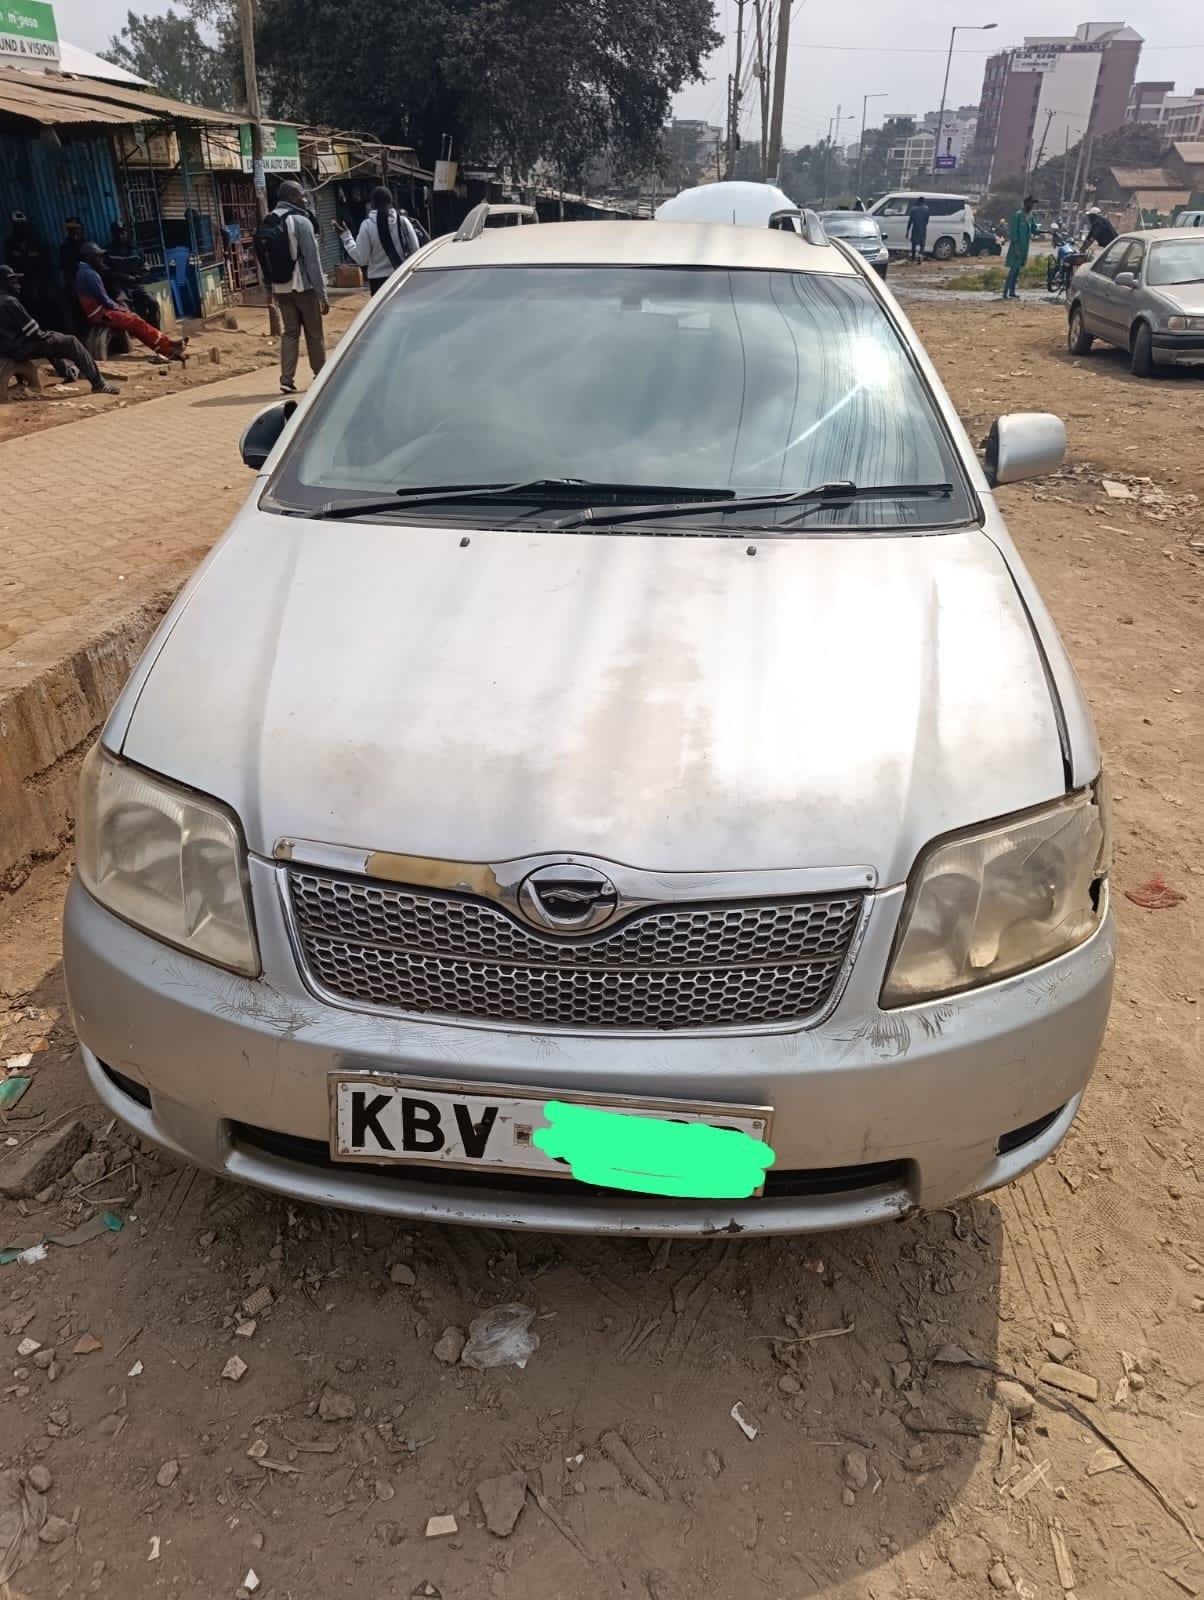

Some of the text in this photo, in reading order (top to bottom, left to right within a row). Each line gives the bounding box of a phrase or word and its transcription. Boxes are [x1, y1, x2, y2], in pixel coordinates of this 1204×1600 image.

[20, 40, 26, 53] &
[27, 41, 55, 56] VISION
[271, 159, 282, 169] AUTO
[350, 1090, 499, 1159] KBV
